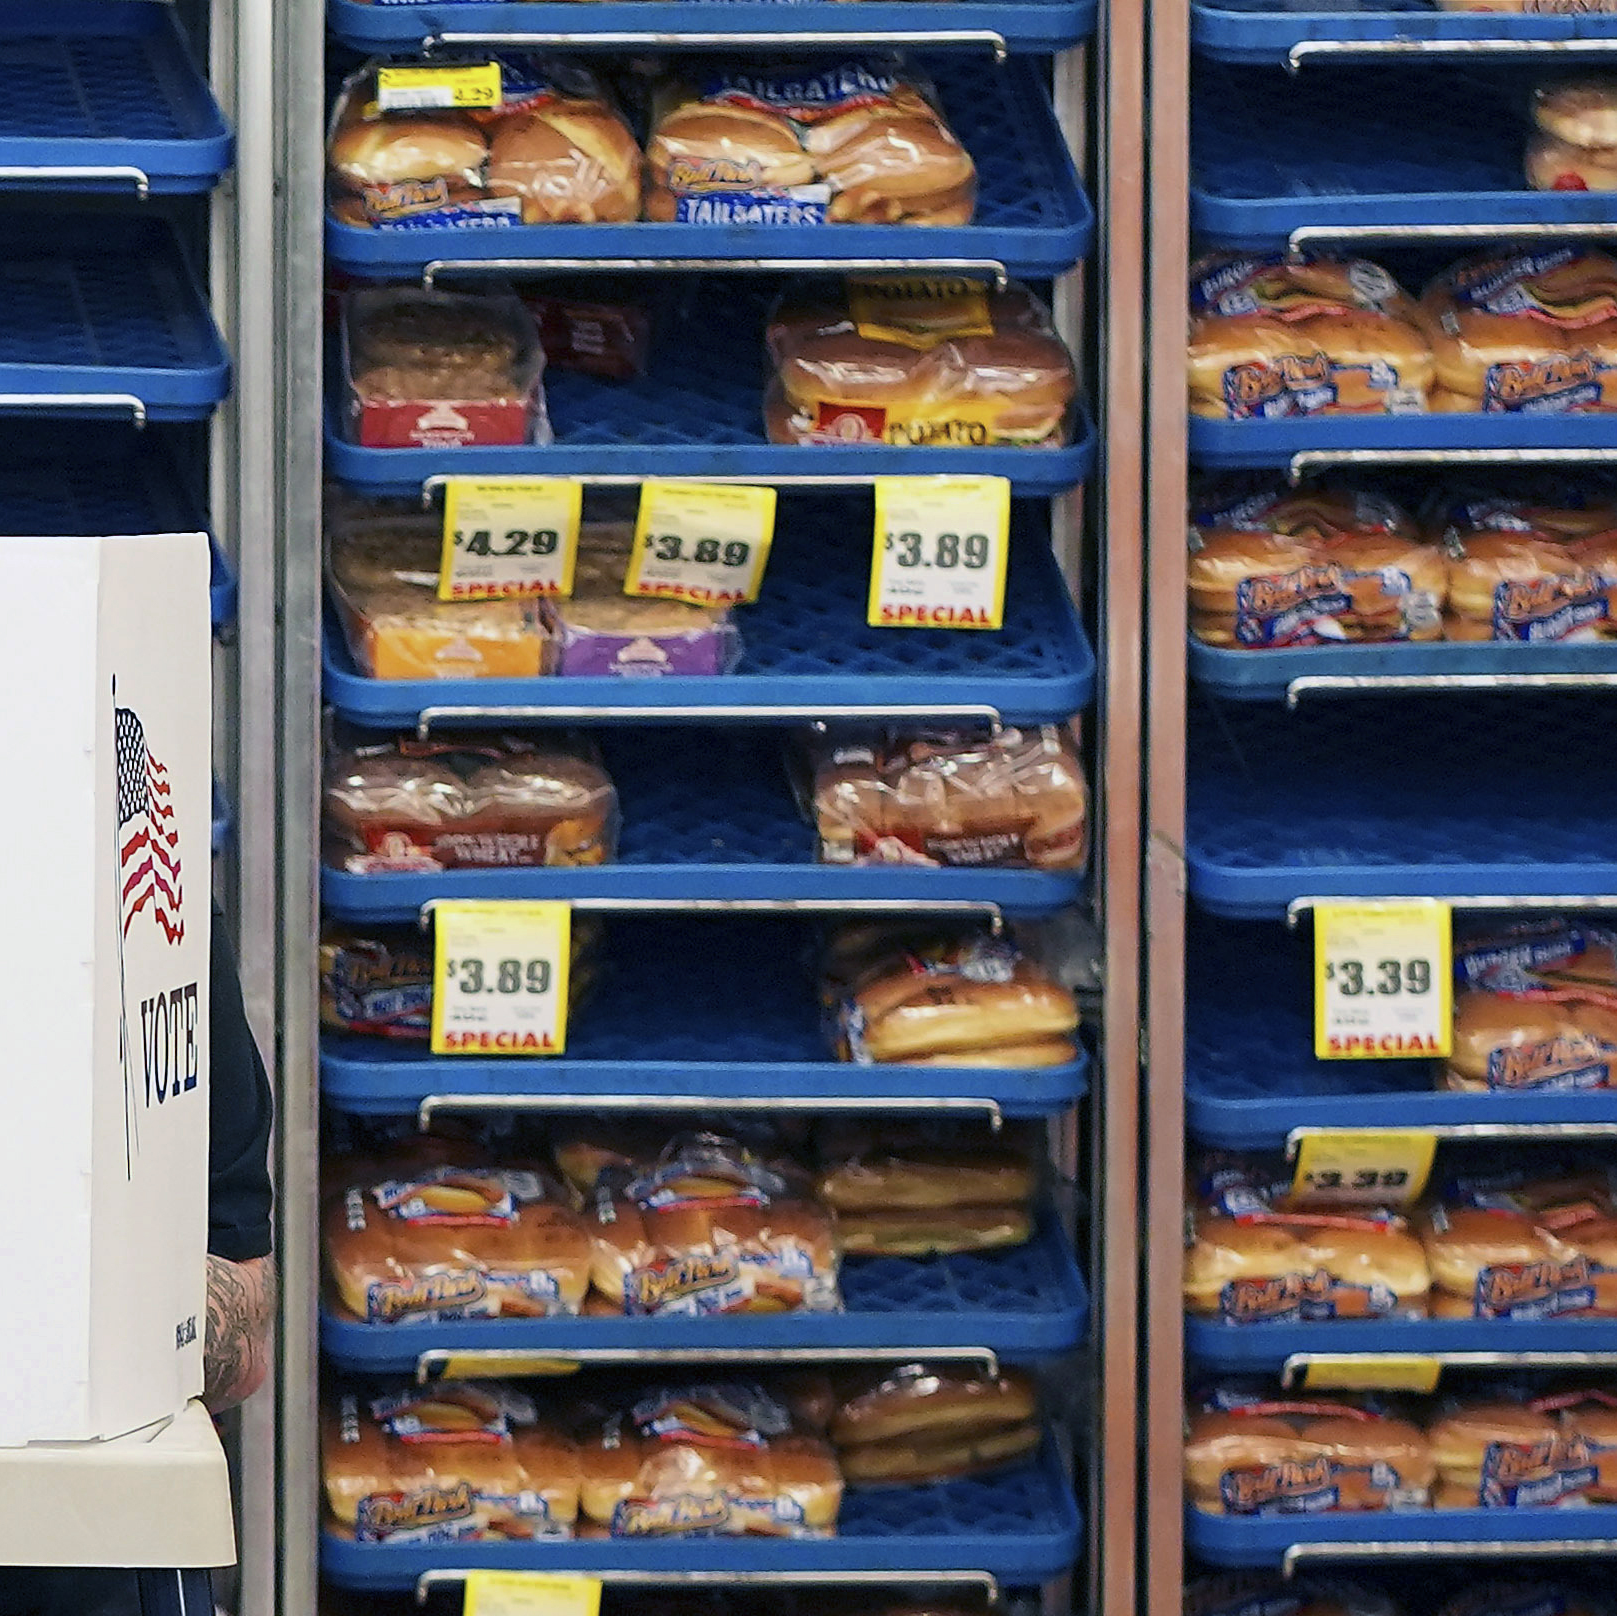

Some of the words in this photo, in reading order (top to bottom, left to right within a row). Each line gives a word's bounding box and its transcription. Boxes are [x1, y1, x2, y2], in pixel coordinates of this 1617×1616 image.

[686, 200, 824, 226] TAILGATERS
[453, 529, 559, 558] $4.29
[643, 531, 750, 568] $3.89
[885, 531, 989, 569] $3.89
[451, 581, 560, 599] SPECIAL
[637, 581, 745, 603] SPECIAL
[881, 605, 990, 625] SPECIAL
[446, 957, 552, 995] $3.89
[1324, 957, 1432, 998] $3.39
[141, 982, 199, 1108] VOTE
[445, 1030, 556, 1049] SPECIAL
[1328, 1033, 1441, 1056] SPECIAL
